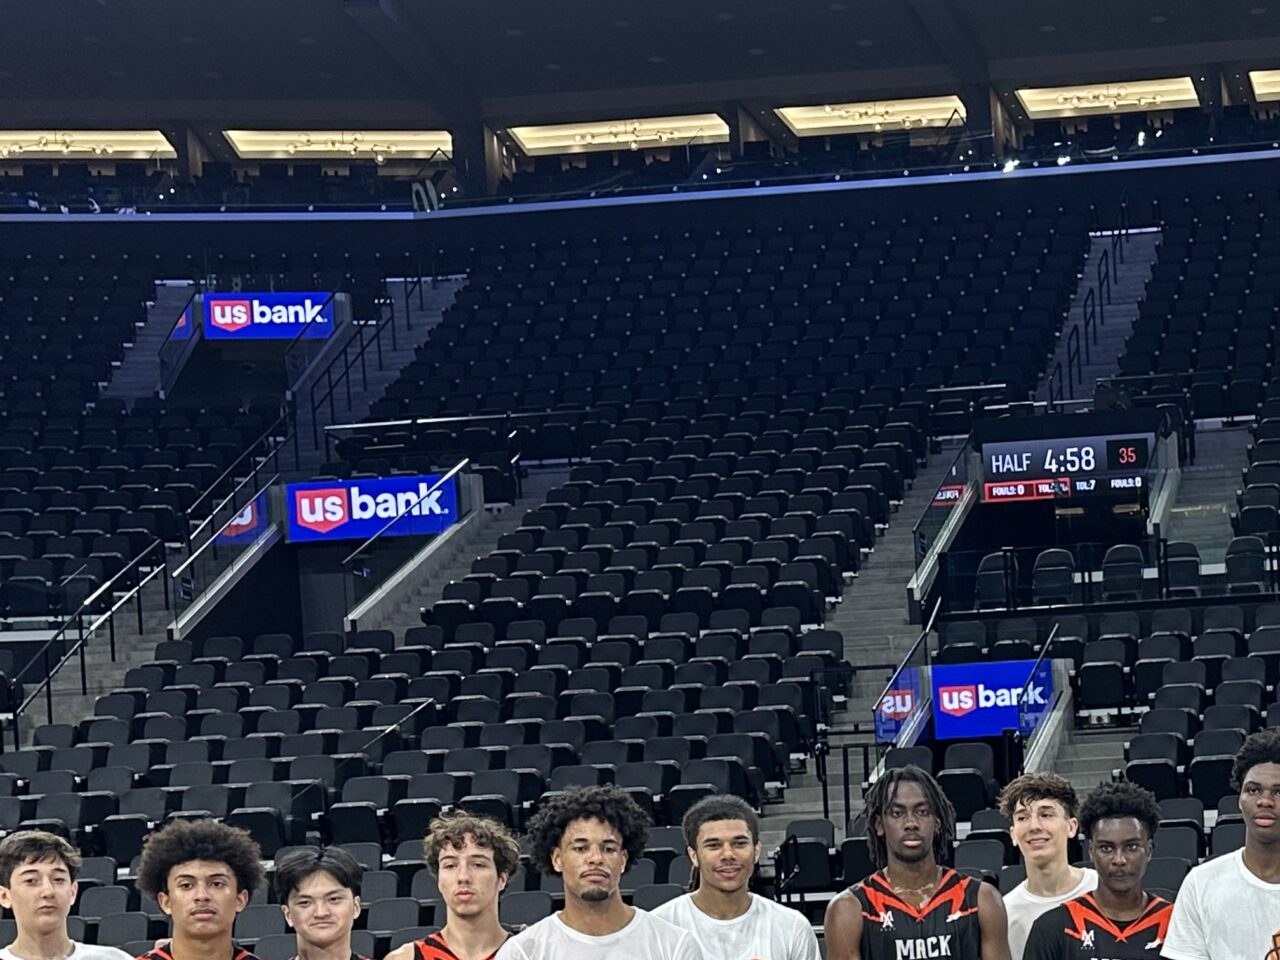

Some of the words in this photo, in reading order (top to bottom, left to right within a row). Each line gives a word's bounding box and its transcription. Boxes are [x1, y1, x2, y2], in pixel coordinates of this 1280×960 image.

[213, 305, 248, 324] us
[991, 452, 1032, 473] HALF
[1044, 446, 1095, 472] 4:58
[1119, 447, 1137, 464] 35
[301, 496, 344, 522] us
[942, 690, 974, 710] us
[894, 934, 952, 960] MACK
